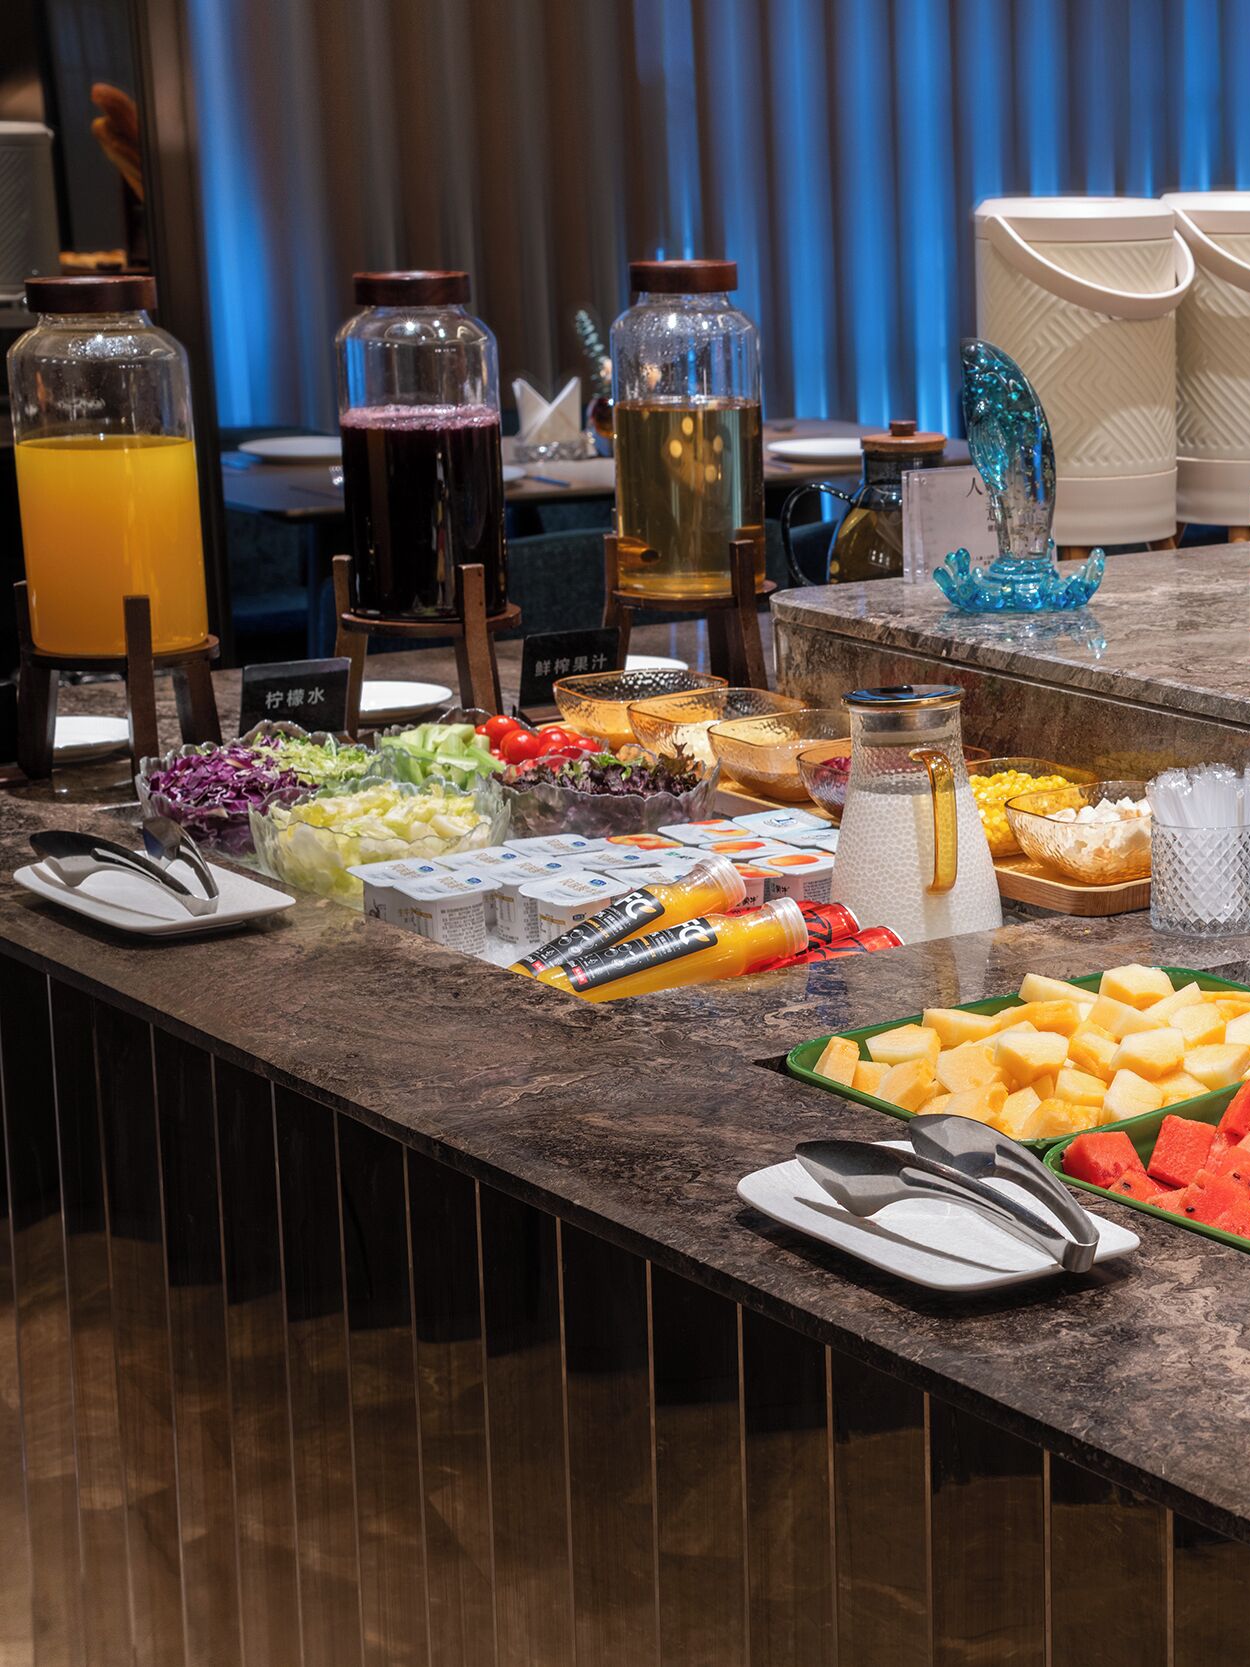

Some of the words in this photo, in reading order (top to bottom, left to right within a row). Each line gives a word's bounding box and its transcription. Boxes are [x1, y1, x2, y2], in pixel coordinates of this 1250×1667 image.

[535, 653, 607, 677] 鲜榨果汁
[265, 687, 325, 710] 柠檬水
